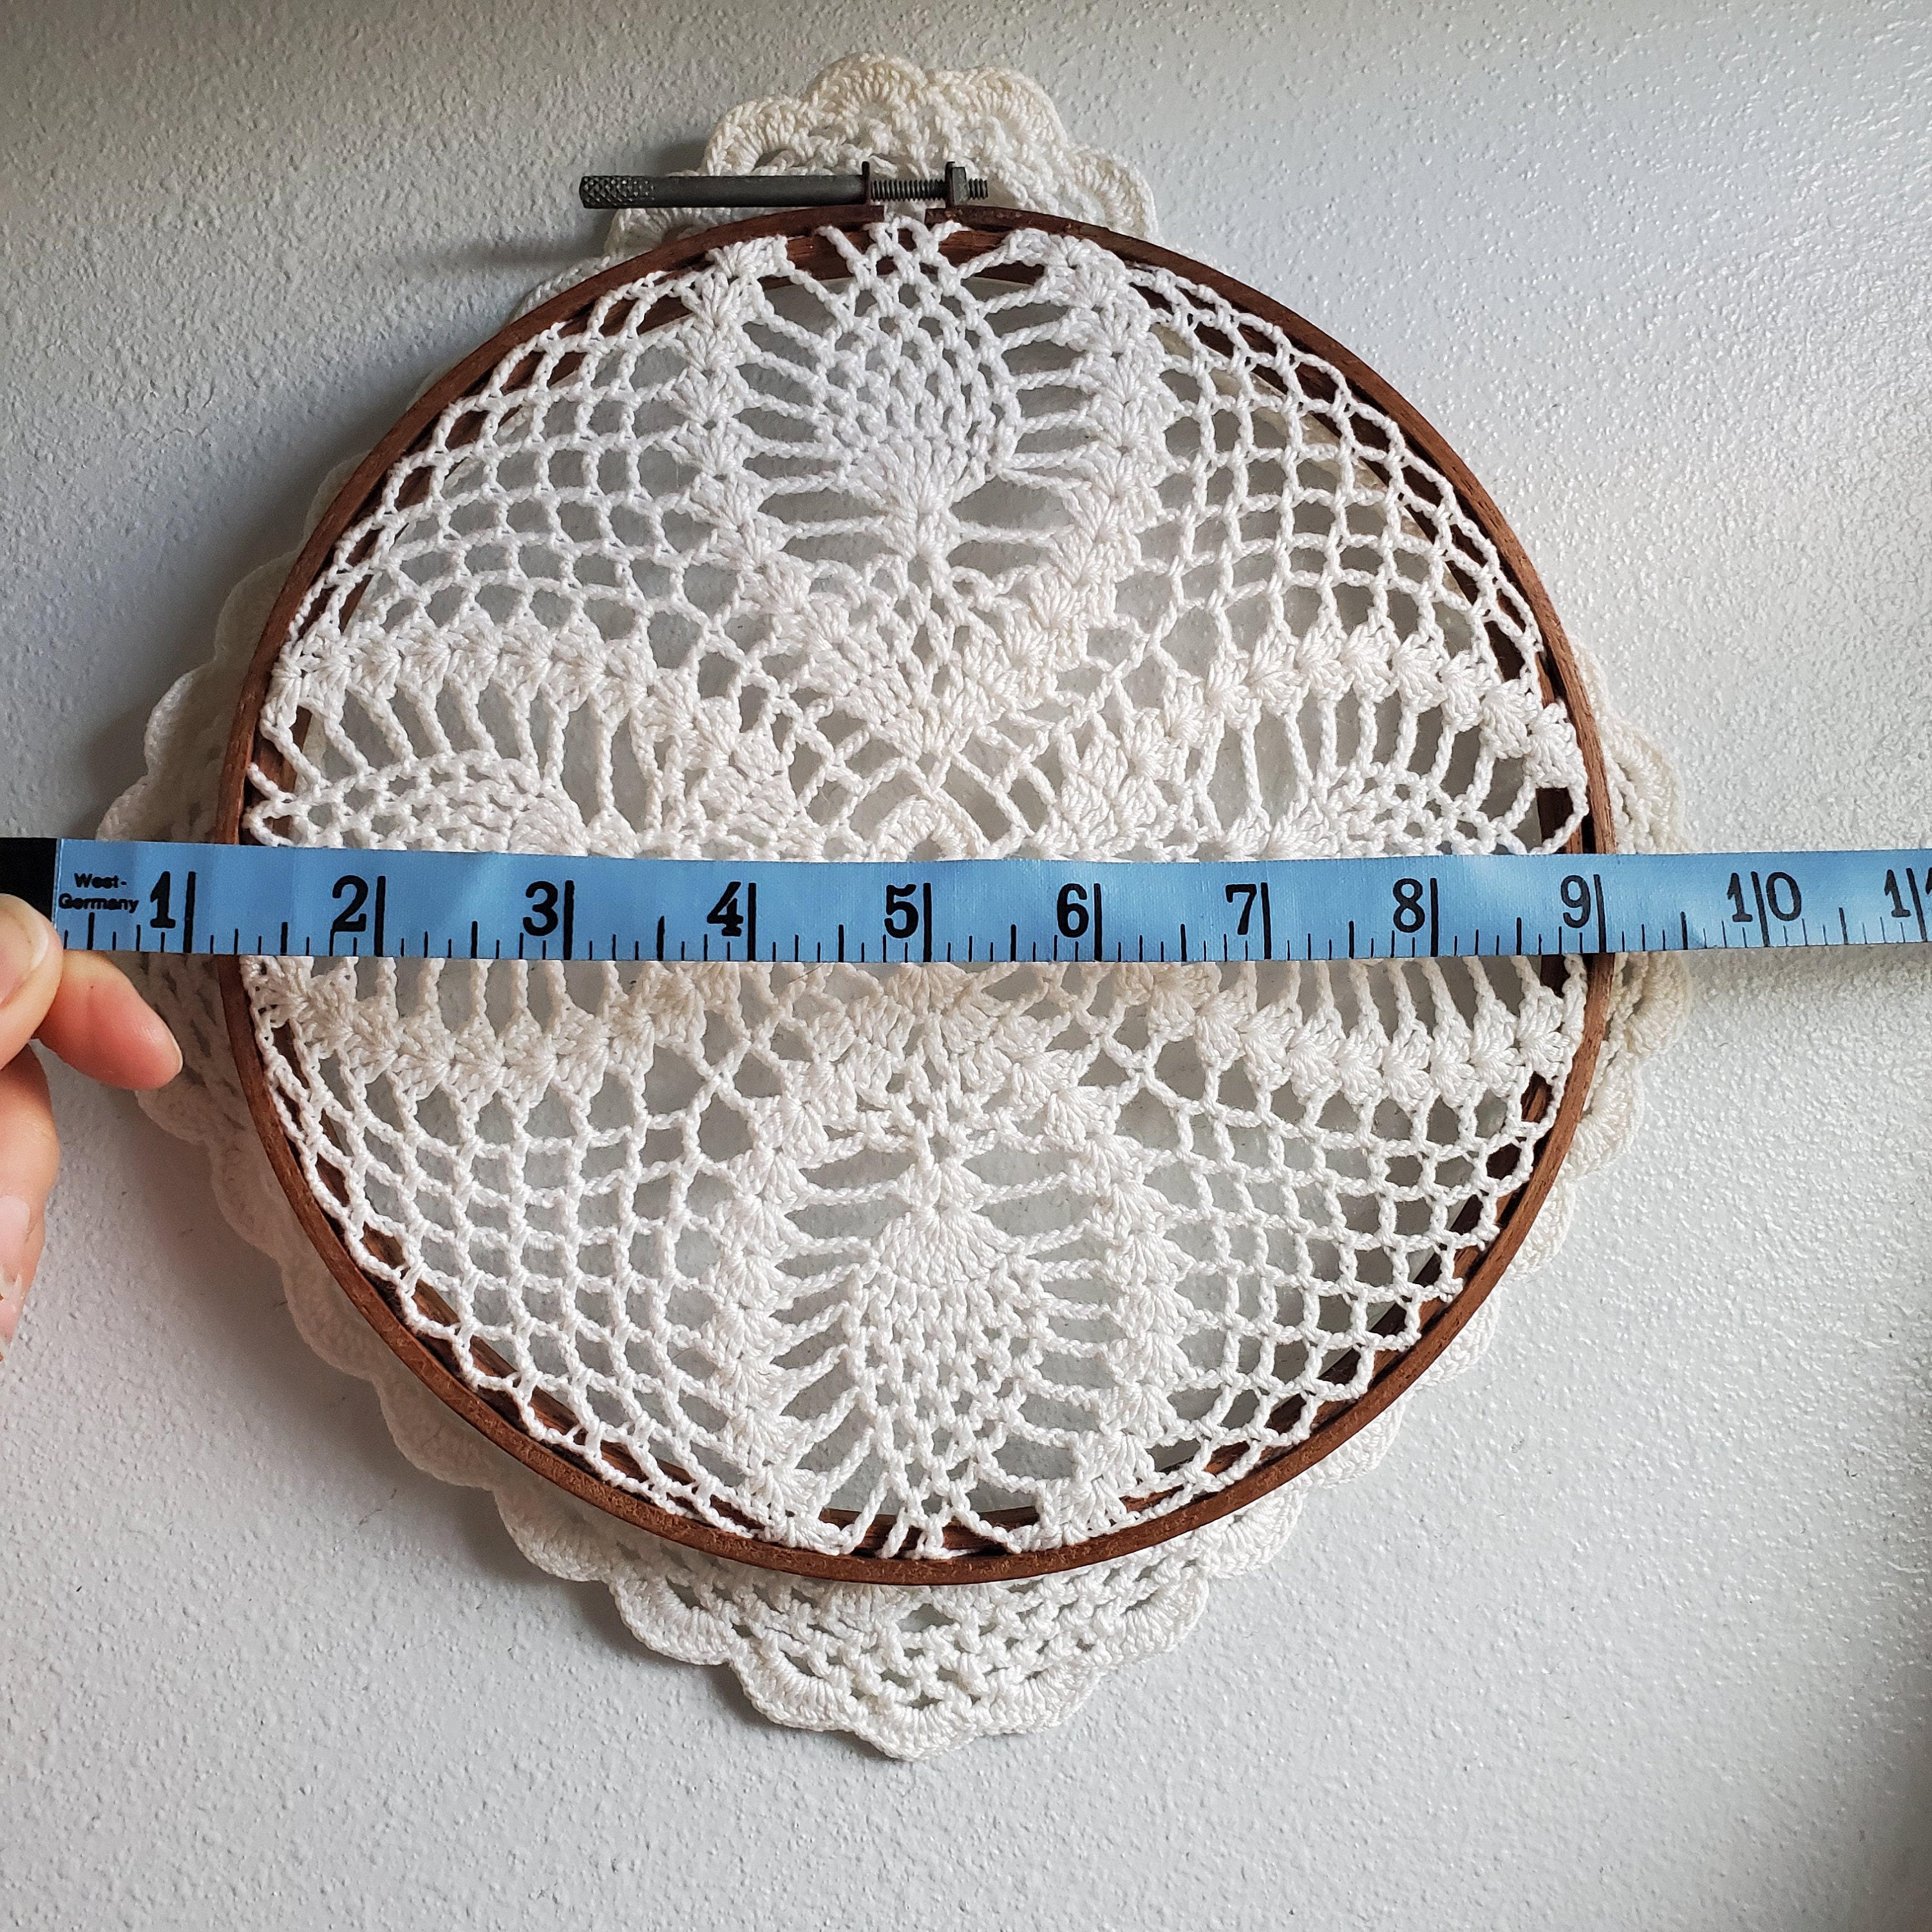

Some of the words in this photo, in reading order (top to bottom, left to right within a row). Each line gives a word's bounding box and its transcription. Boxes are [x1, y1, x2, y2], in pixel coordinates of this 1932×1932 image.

[59, 893, 139, 913] Germany
[150, 871, 176, 929] 1
[332, 875, 368, 933] 2
[523, 881, 558, 936] 3
[706, 881, 743, 936] 4
[884, 884, 919, 938] 5
[1056, 884, 1089, 938] 6
[1225, 884, 1257, 935] 7
[1392, 878, 1425, 933] 8
[1560, 875, 1591, 928] 9
